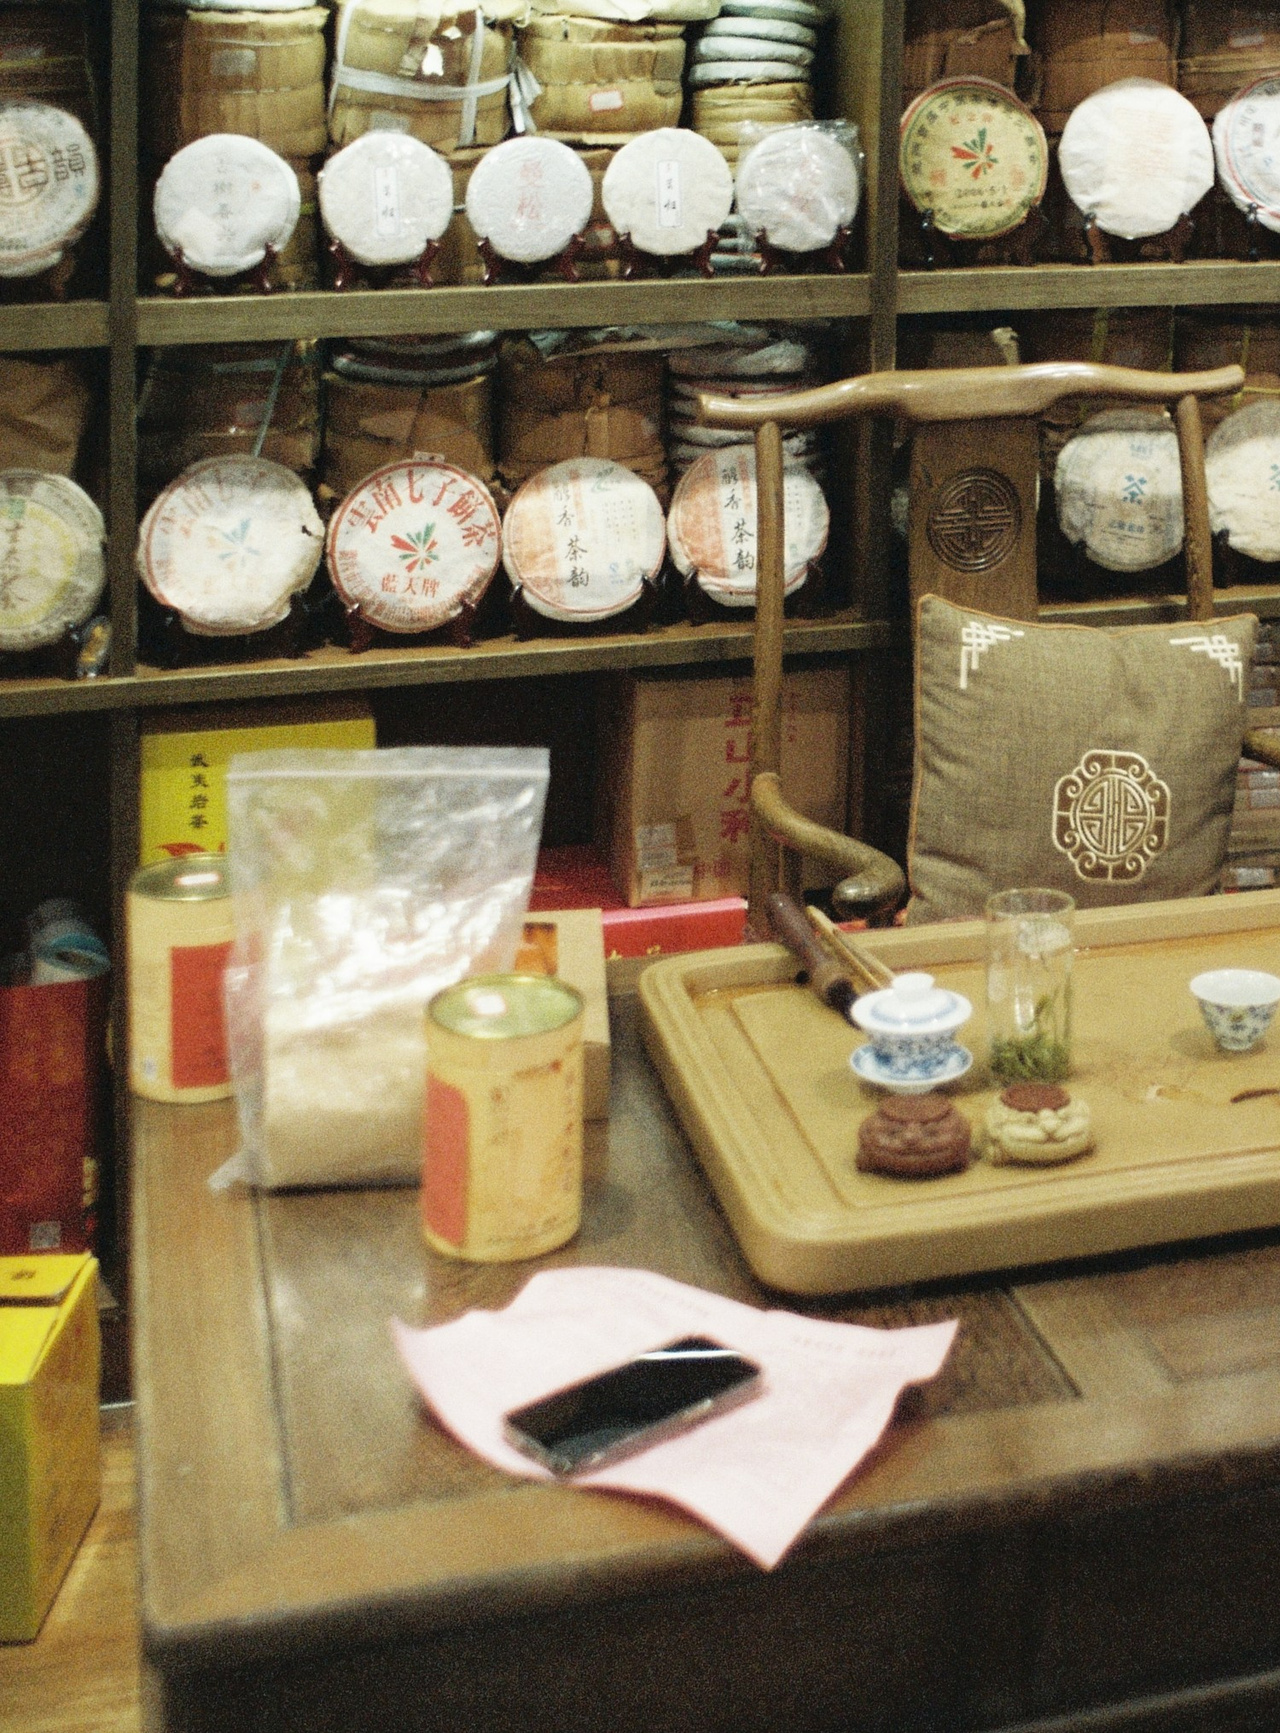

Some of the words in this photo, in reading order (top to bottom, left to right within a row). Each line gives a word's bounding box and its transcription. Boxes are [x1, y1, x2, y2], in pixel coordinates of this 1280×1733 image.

[347, 468, 497, 547] 雲南七子餅茶
[1122, 474, 1148, 506] 茶
[189, 753, 210, 829] 武夷岩茶
